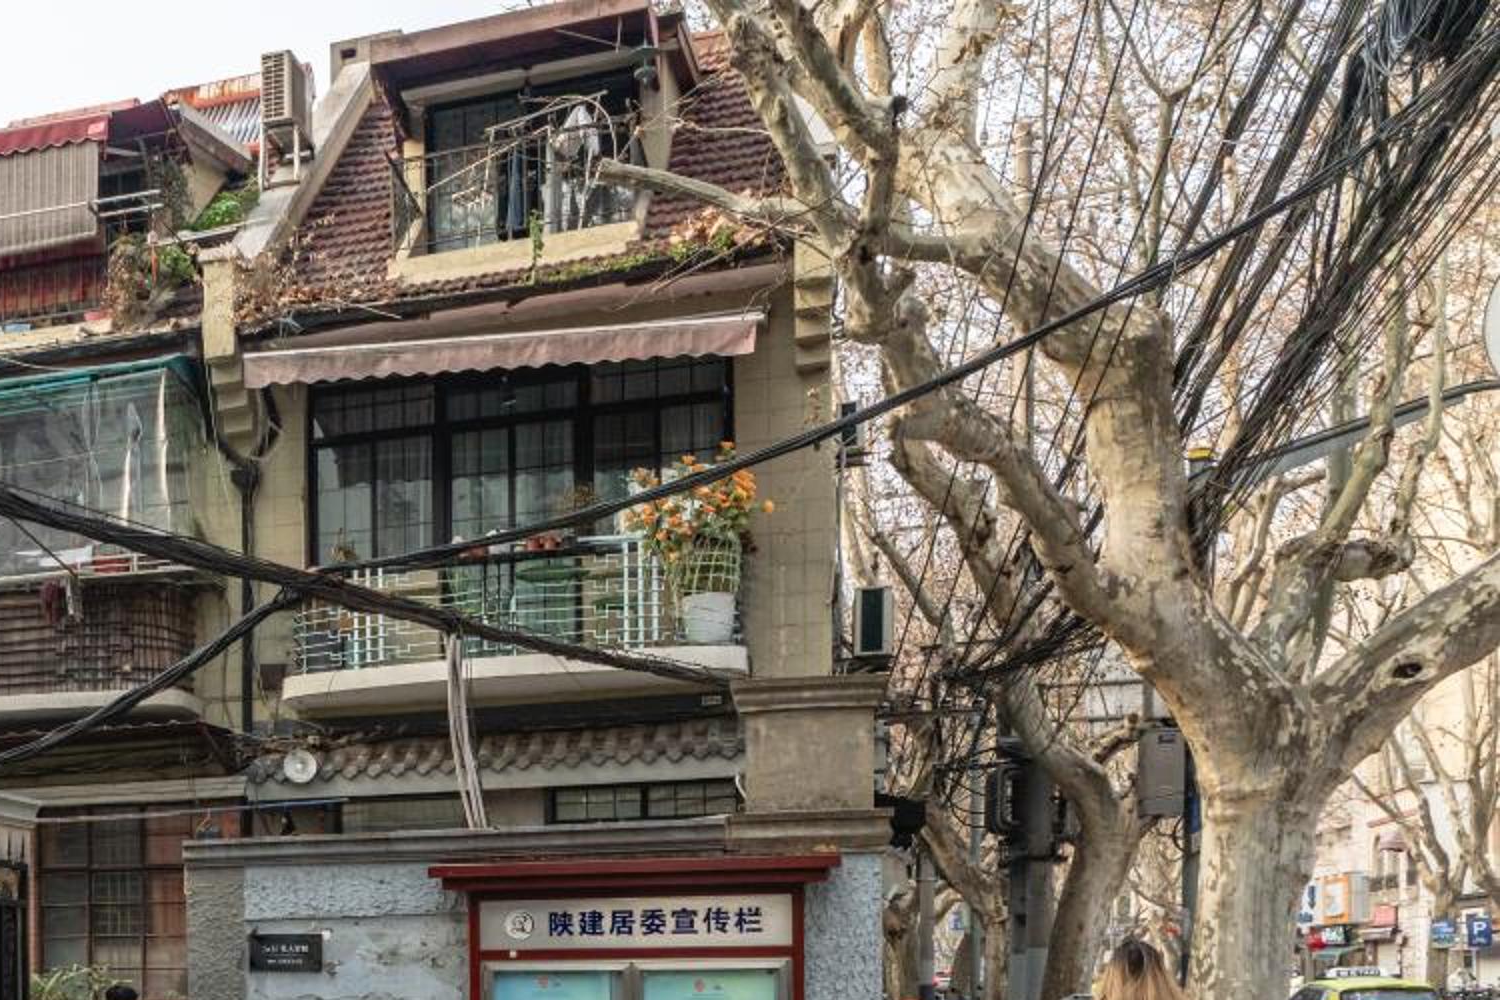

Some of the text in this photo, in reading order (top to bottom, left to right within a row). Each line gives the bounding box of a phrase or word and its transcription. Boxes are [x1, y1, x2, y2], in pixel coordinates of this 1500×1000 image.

[547, 906, 764, 937] 陕建居委宣传栏
[1473, 920, 1487, 935] P
